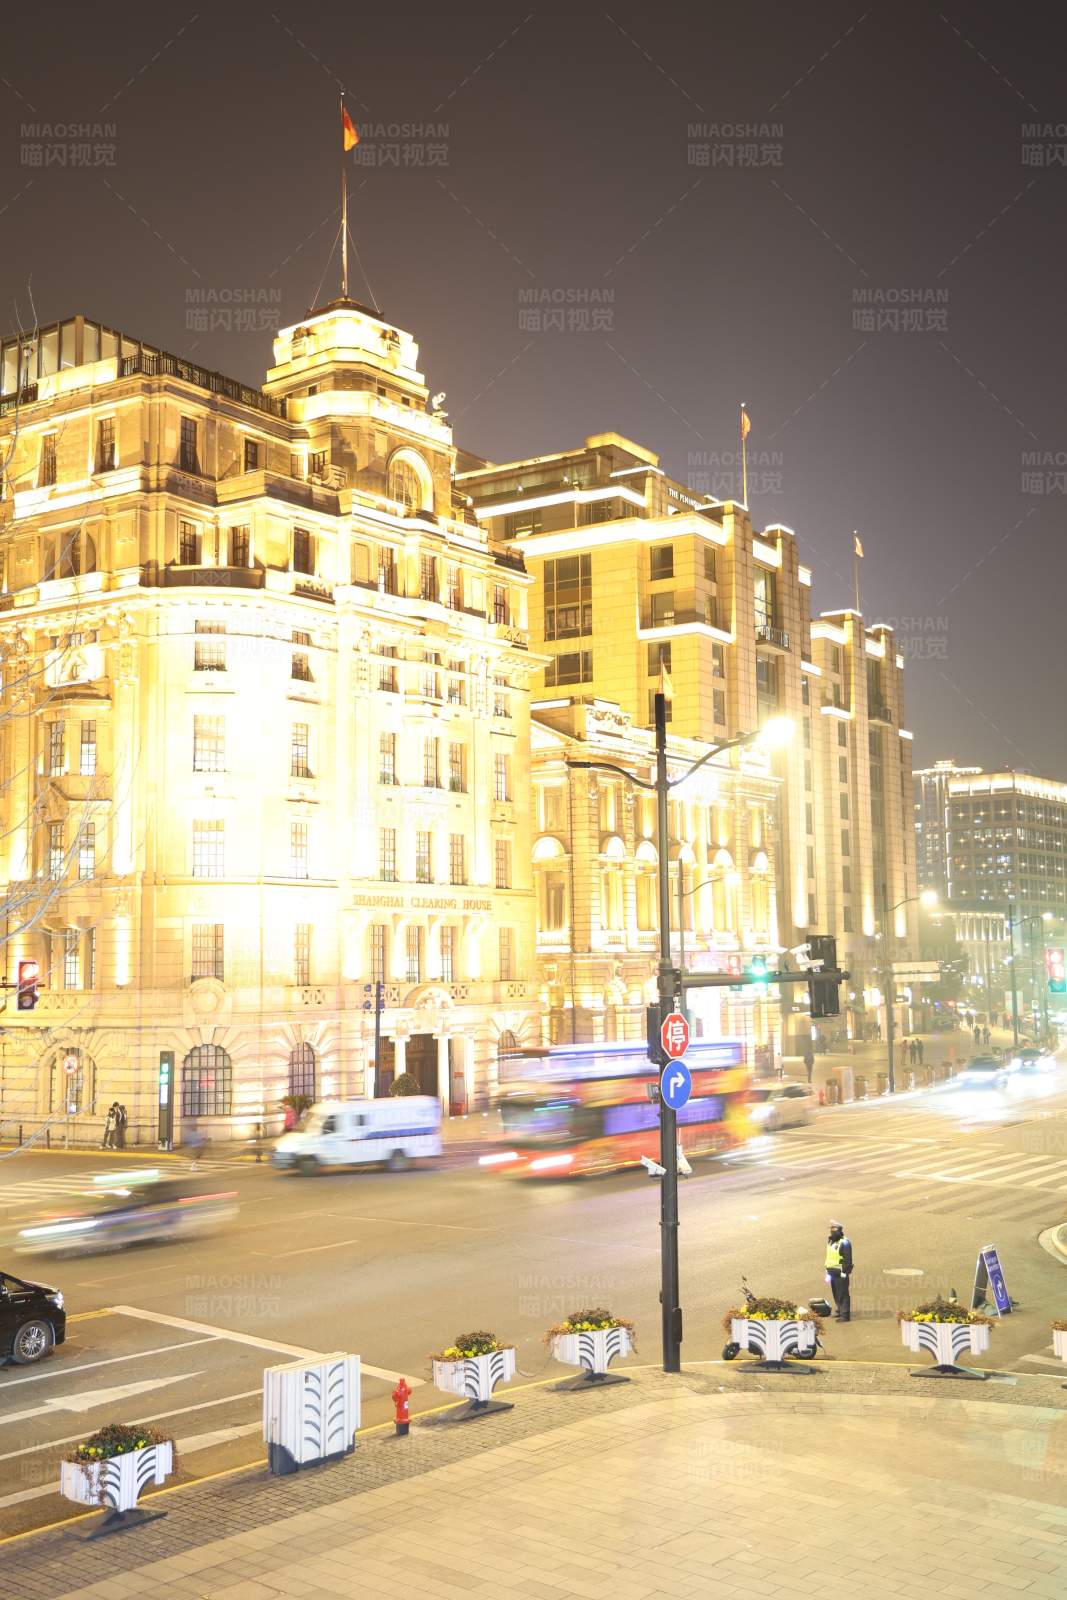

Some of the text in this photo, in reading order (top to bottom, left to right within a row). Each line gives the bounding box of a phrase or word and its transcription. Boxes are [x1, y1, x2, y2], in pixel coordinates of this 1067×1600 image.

[353, 894, 492, 911] SHANGHAI CLEARING HOUSE
[666, 1020, 686, 1052] 停
